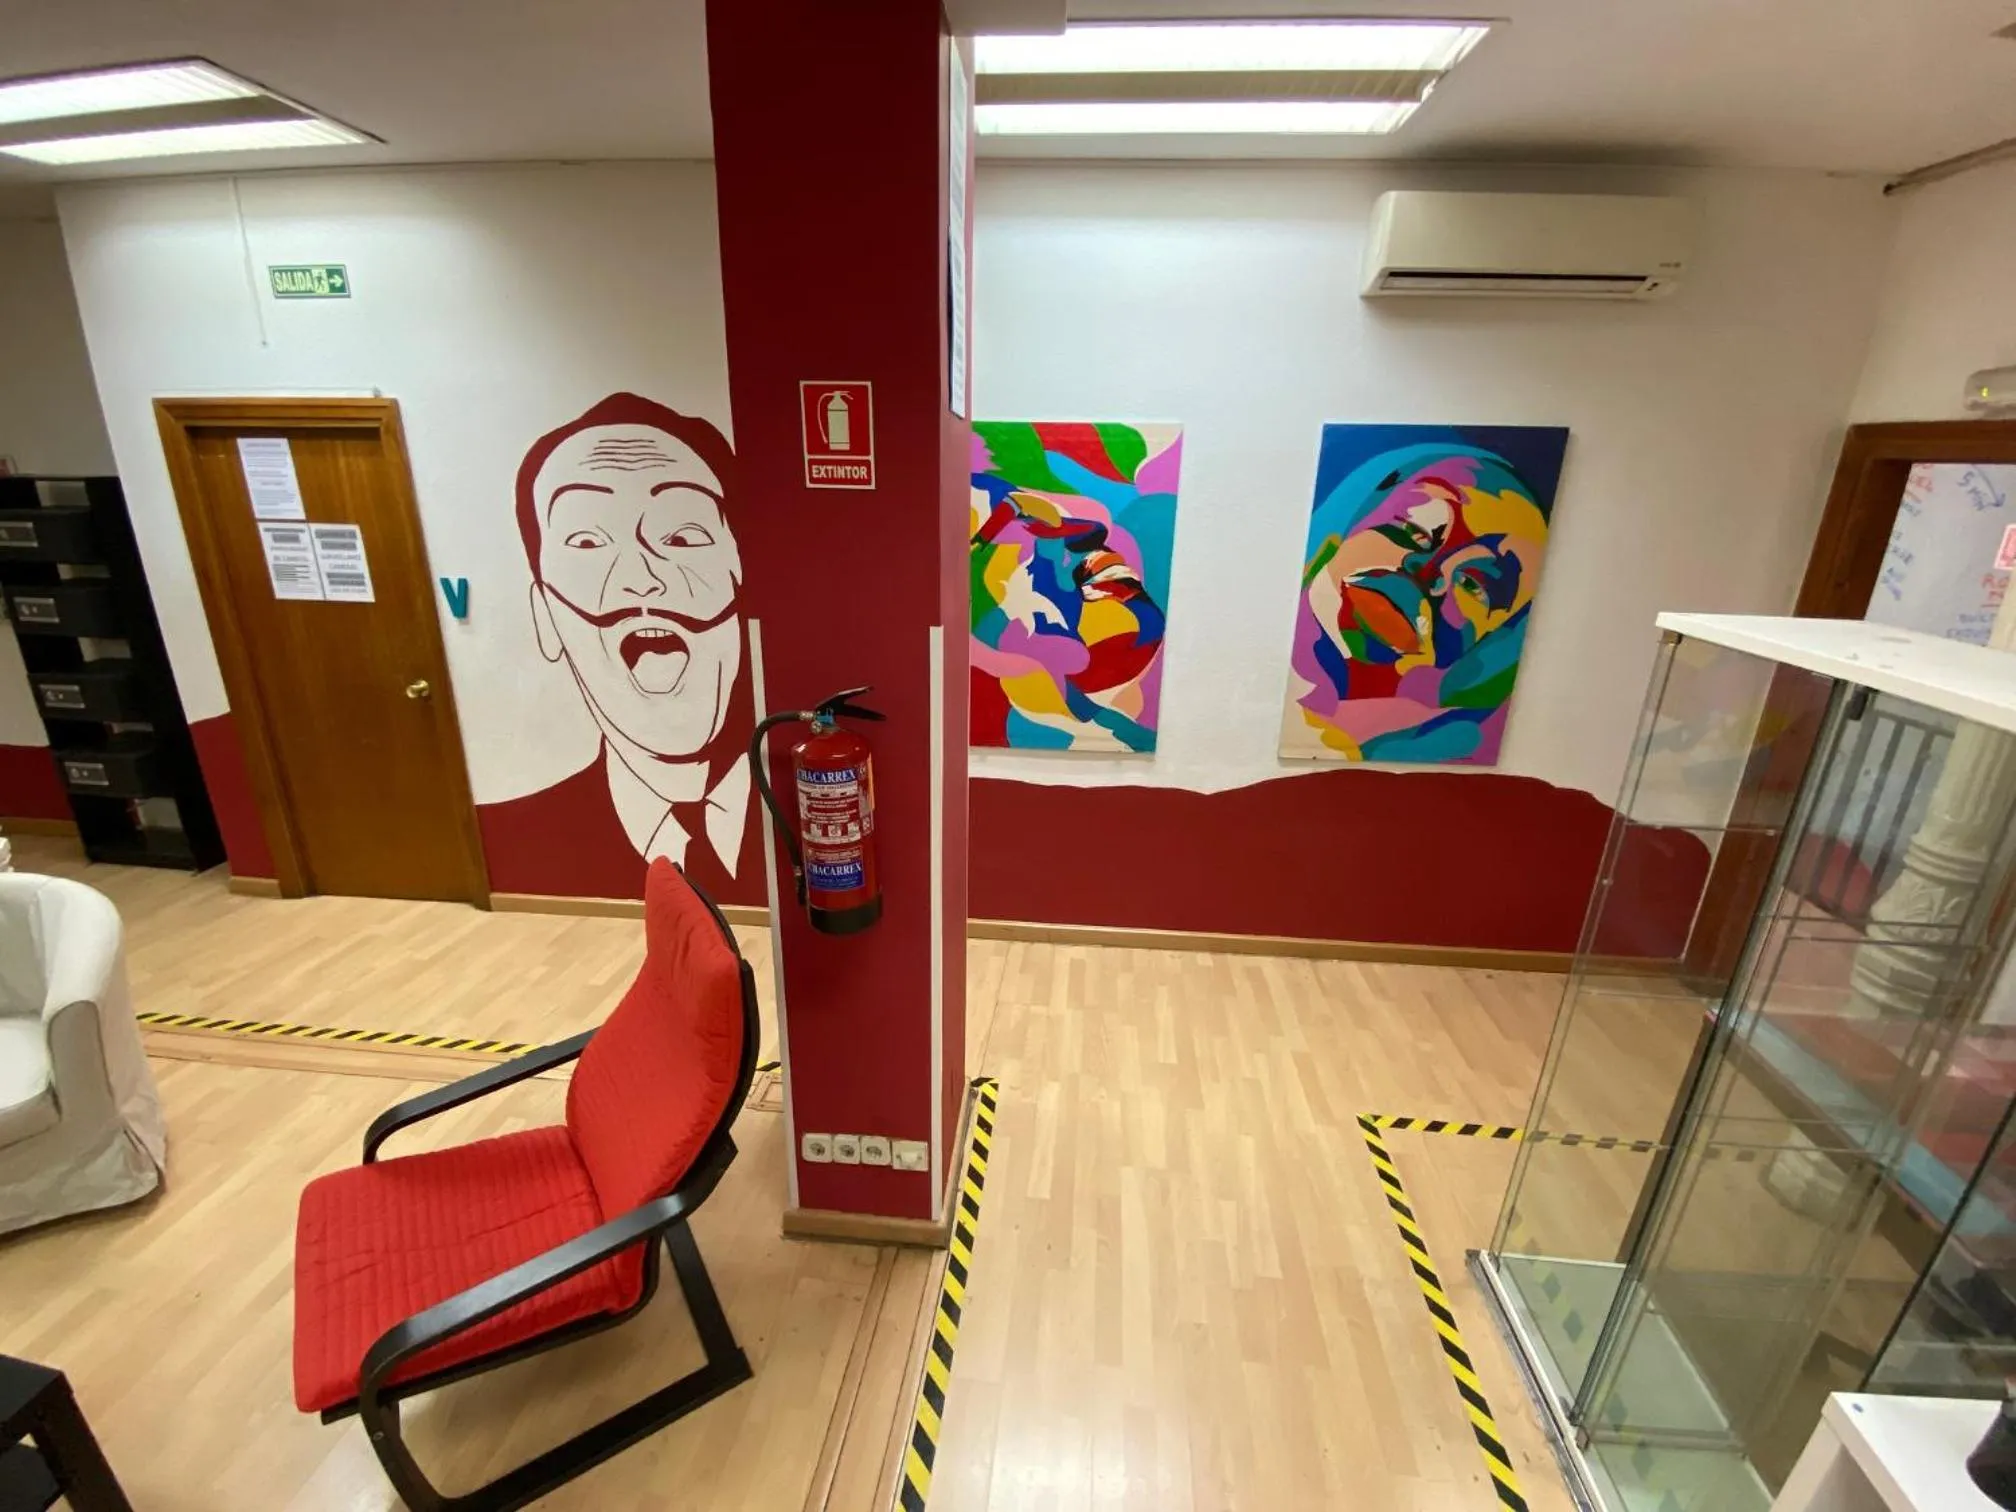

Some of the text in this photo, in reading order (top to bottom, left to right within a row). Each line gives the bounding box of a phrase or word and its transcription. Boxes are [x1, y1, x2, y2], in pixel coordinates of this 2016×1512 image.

[274, 271, 314, 292] SALIDA
[811, 465, 869, 480] EXTINTOR
[439, 577, 468, 620] V
